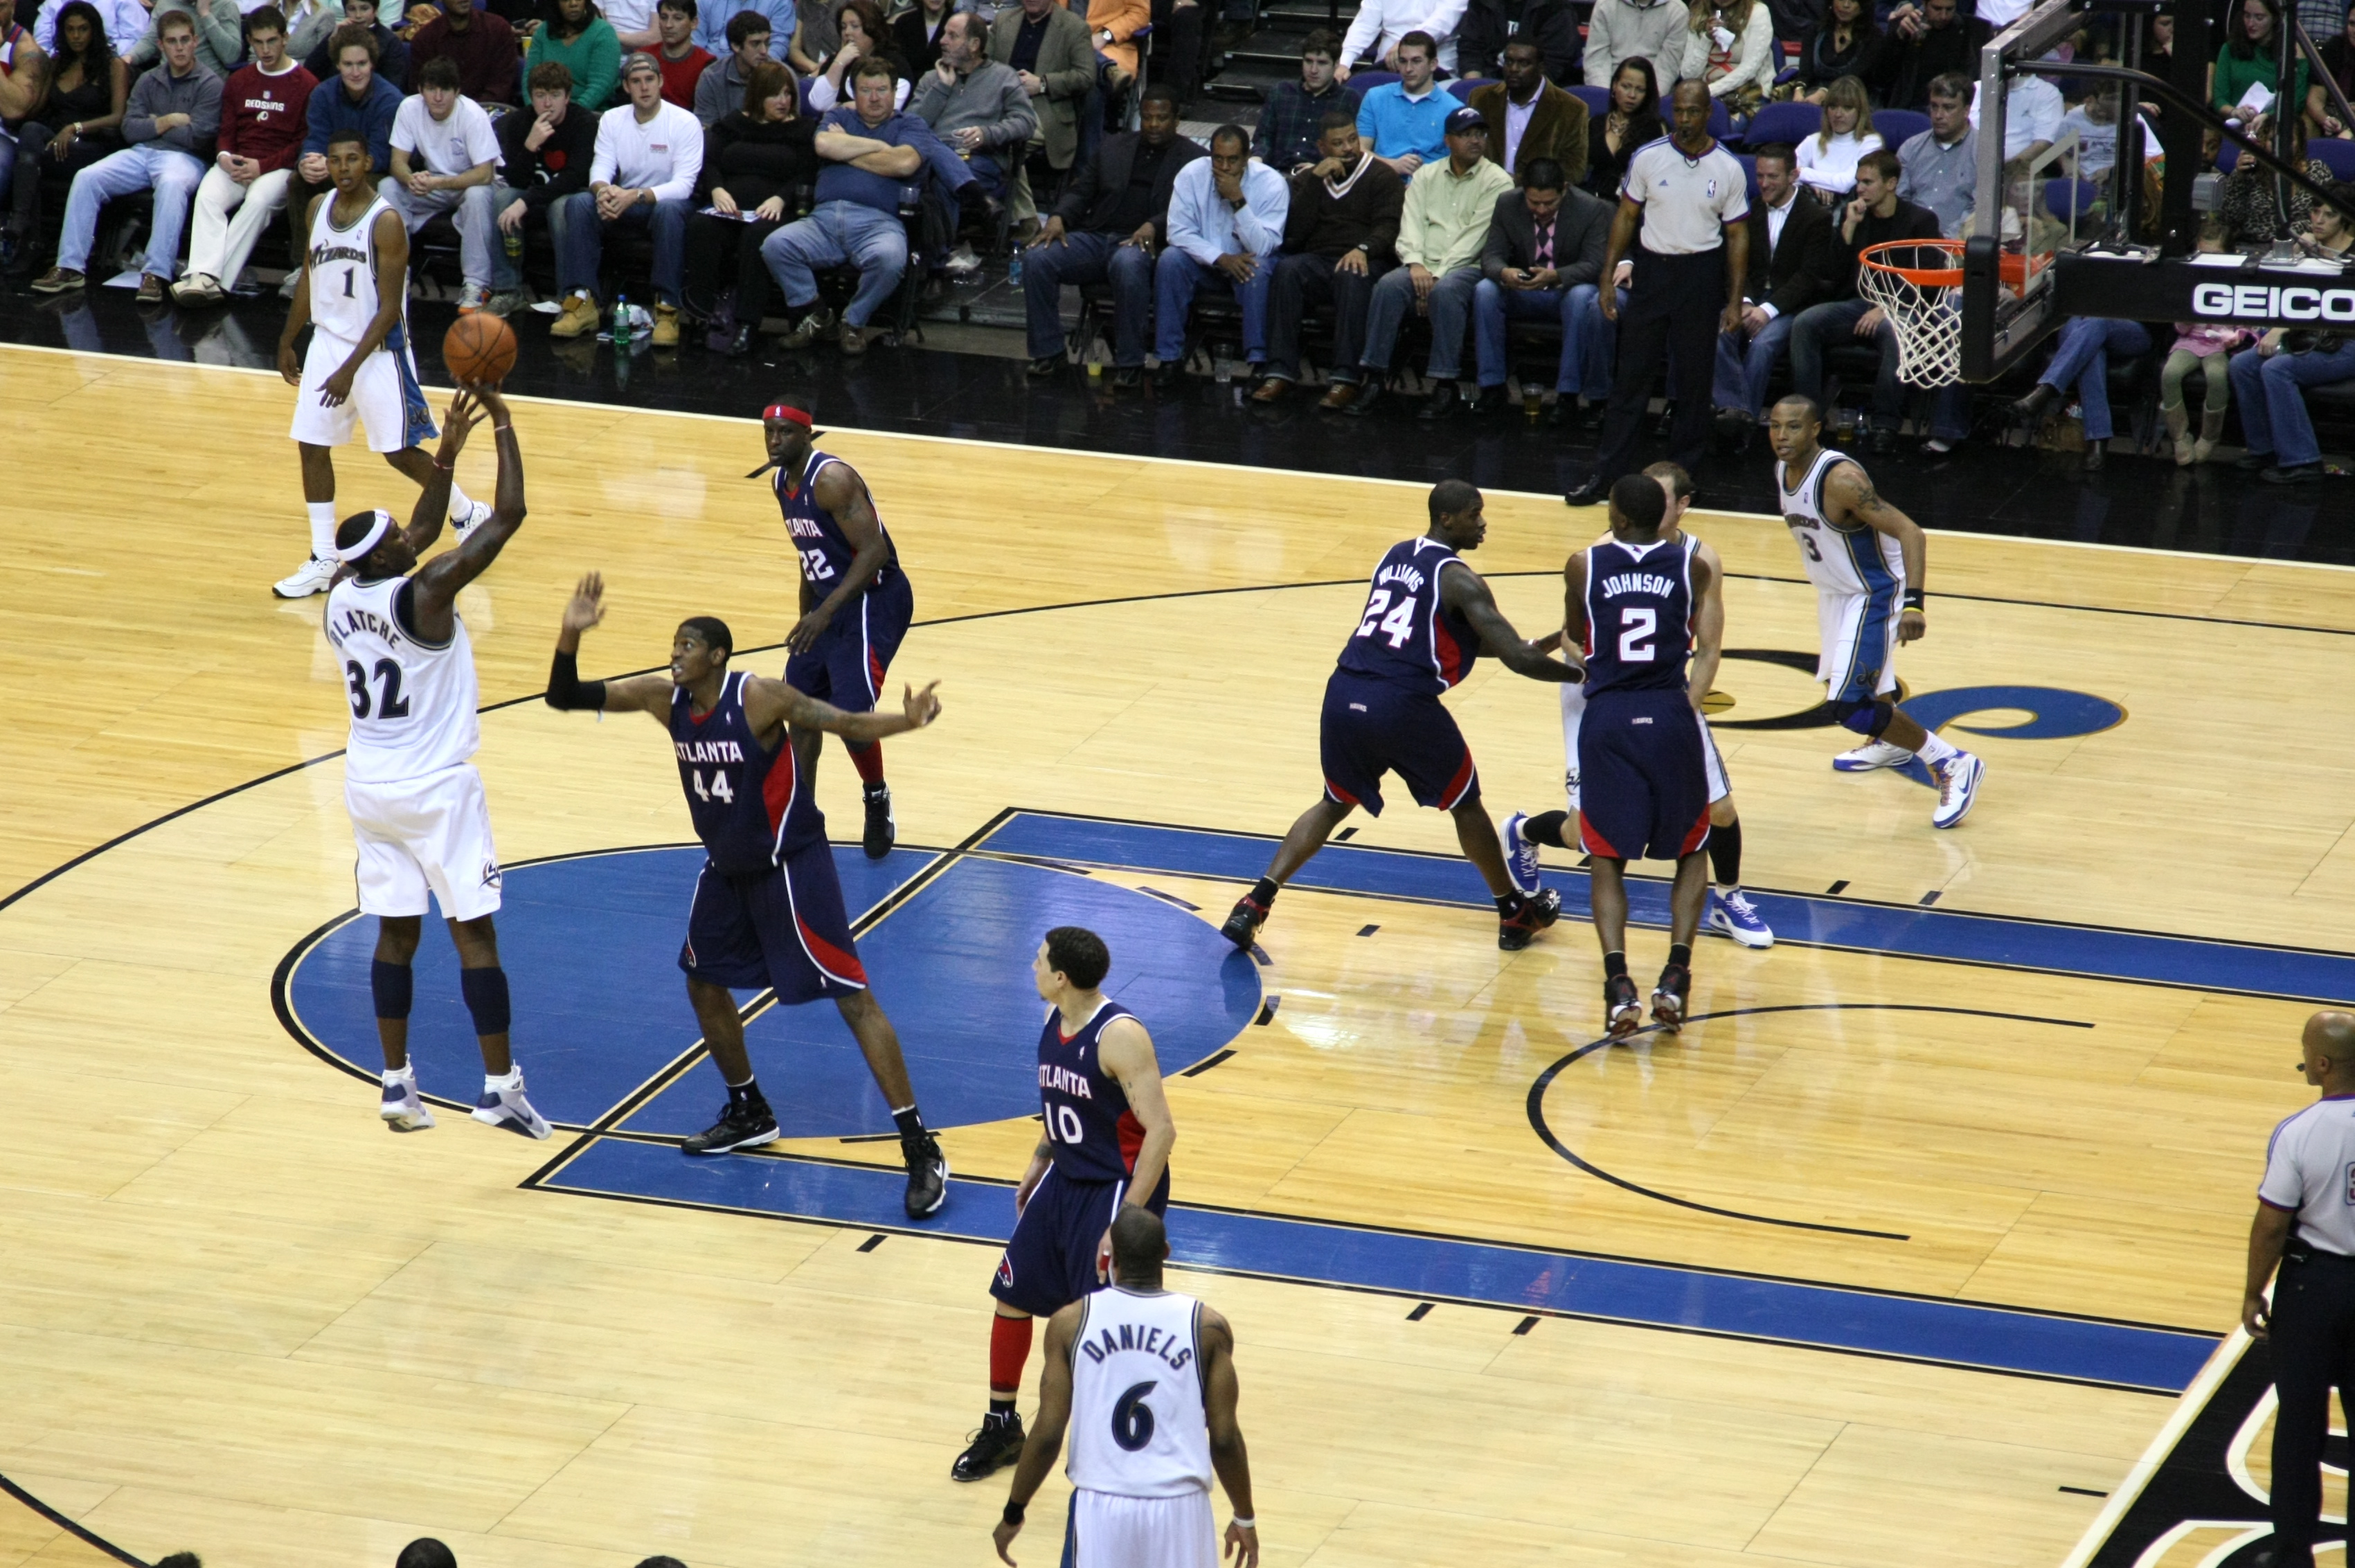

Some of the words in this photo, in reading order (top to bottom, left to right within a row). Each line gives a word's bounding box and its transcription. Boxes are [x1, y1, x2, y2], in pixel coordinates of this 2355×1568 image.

[244, 99, 285, 111] REDSKINS
[342, 266, 356, 299] 1
[2193, 283, 2355, 321] GEICO
[798, 548, 834, 580] 22
[1801, 532, 1823, 562] 3
[1379, 564, 1424, 593] WILLIAMS
[1602, 573, 1675, 598] JOHNSON
[330, 610, 401, 649] BLATCHE
[1356, 589, 1417, 648] 24
[1620, 607, 1656, 661] 2
[346, 658, 409, 719] 32
[693, 769, 734, 803] 44
[1045, 1102, 1083, 1144] 10
[1081, 1324, 1192, 1371] DANIELS
[1111, 1380, 1159, 1452] 6
